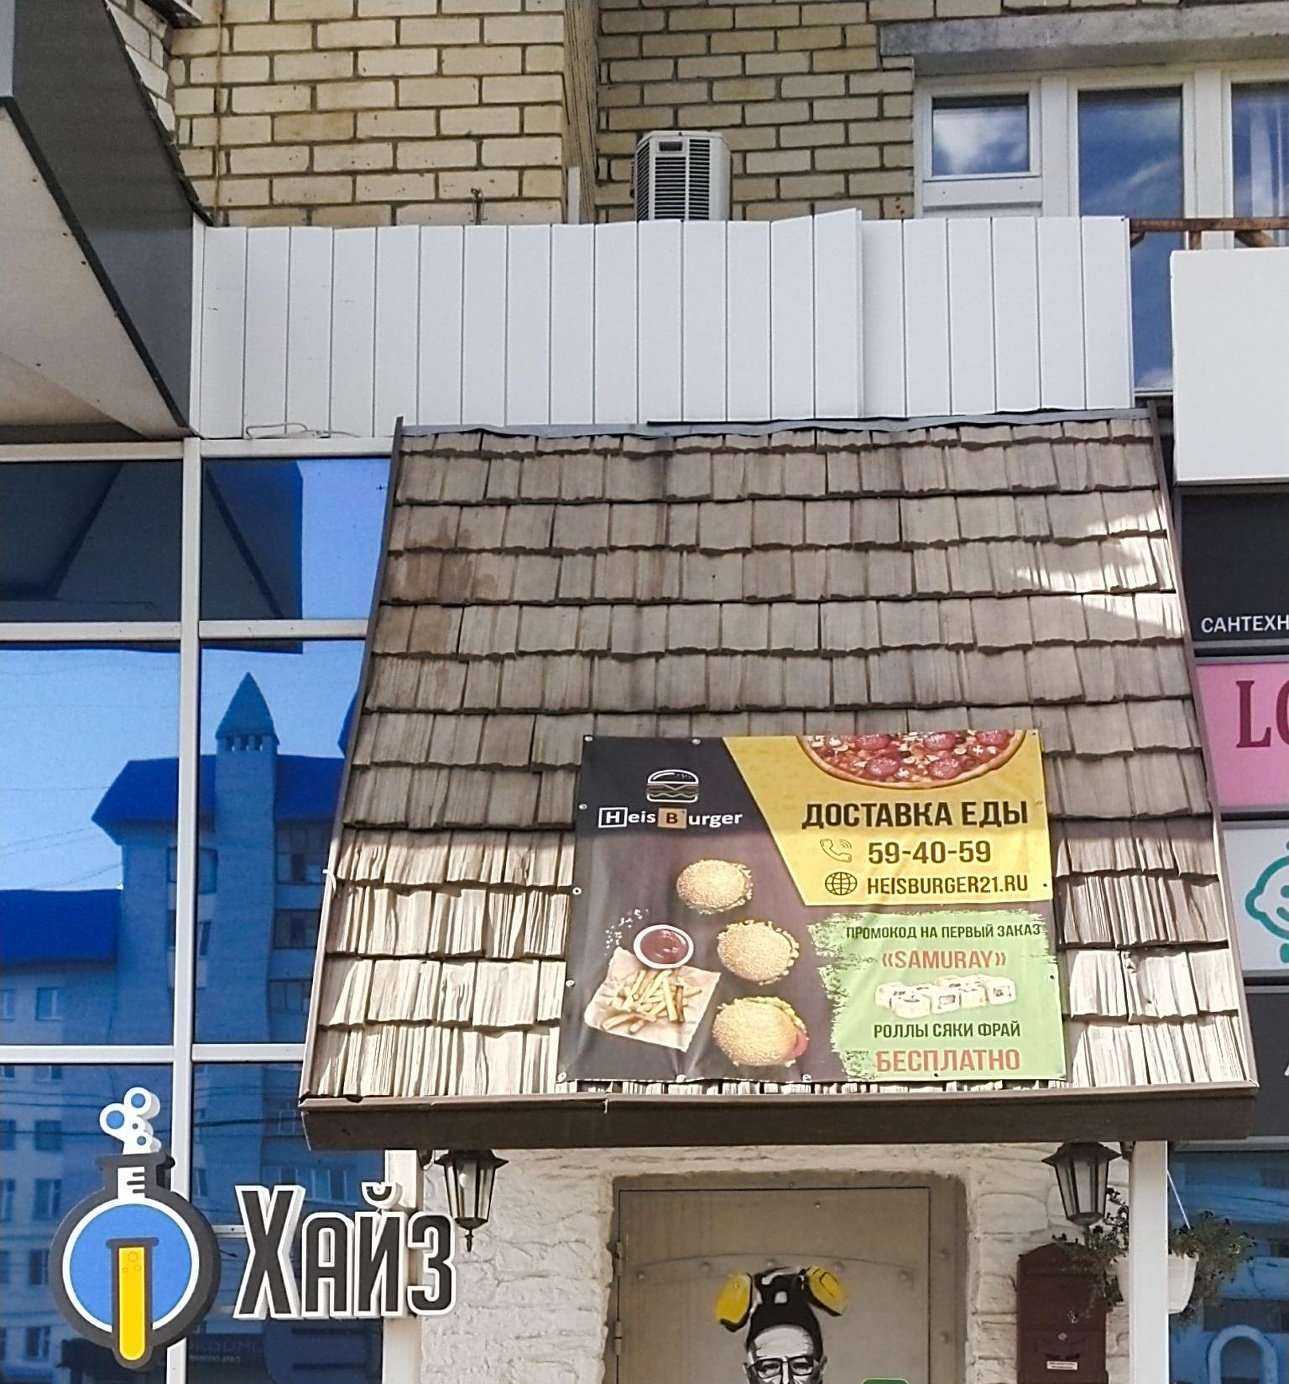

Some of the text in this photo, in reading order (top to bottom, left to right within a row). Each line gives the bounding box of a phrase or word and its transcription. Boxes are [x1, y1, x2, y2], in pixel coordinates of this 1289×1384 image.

[801, 800, 1028, 830] ДОСТАВКА ЕДЫ
[868, 840, 992, 864] 59-40-59
[867, 874, 1029, 895] HEISBURGER21.RU
[846, 924, 1041, 939] ПРОМОКОД НА ПЕРВЫЙ ЗАКАЗ
[882, 950, 1007, 969] «SAMURAY»
[874, 1020, 1021, 1038] РОЛЛЫ СЯКИ ФРАЙ
[876, 1050, 1020, 1072] БЕСПЛАТНО
